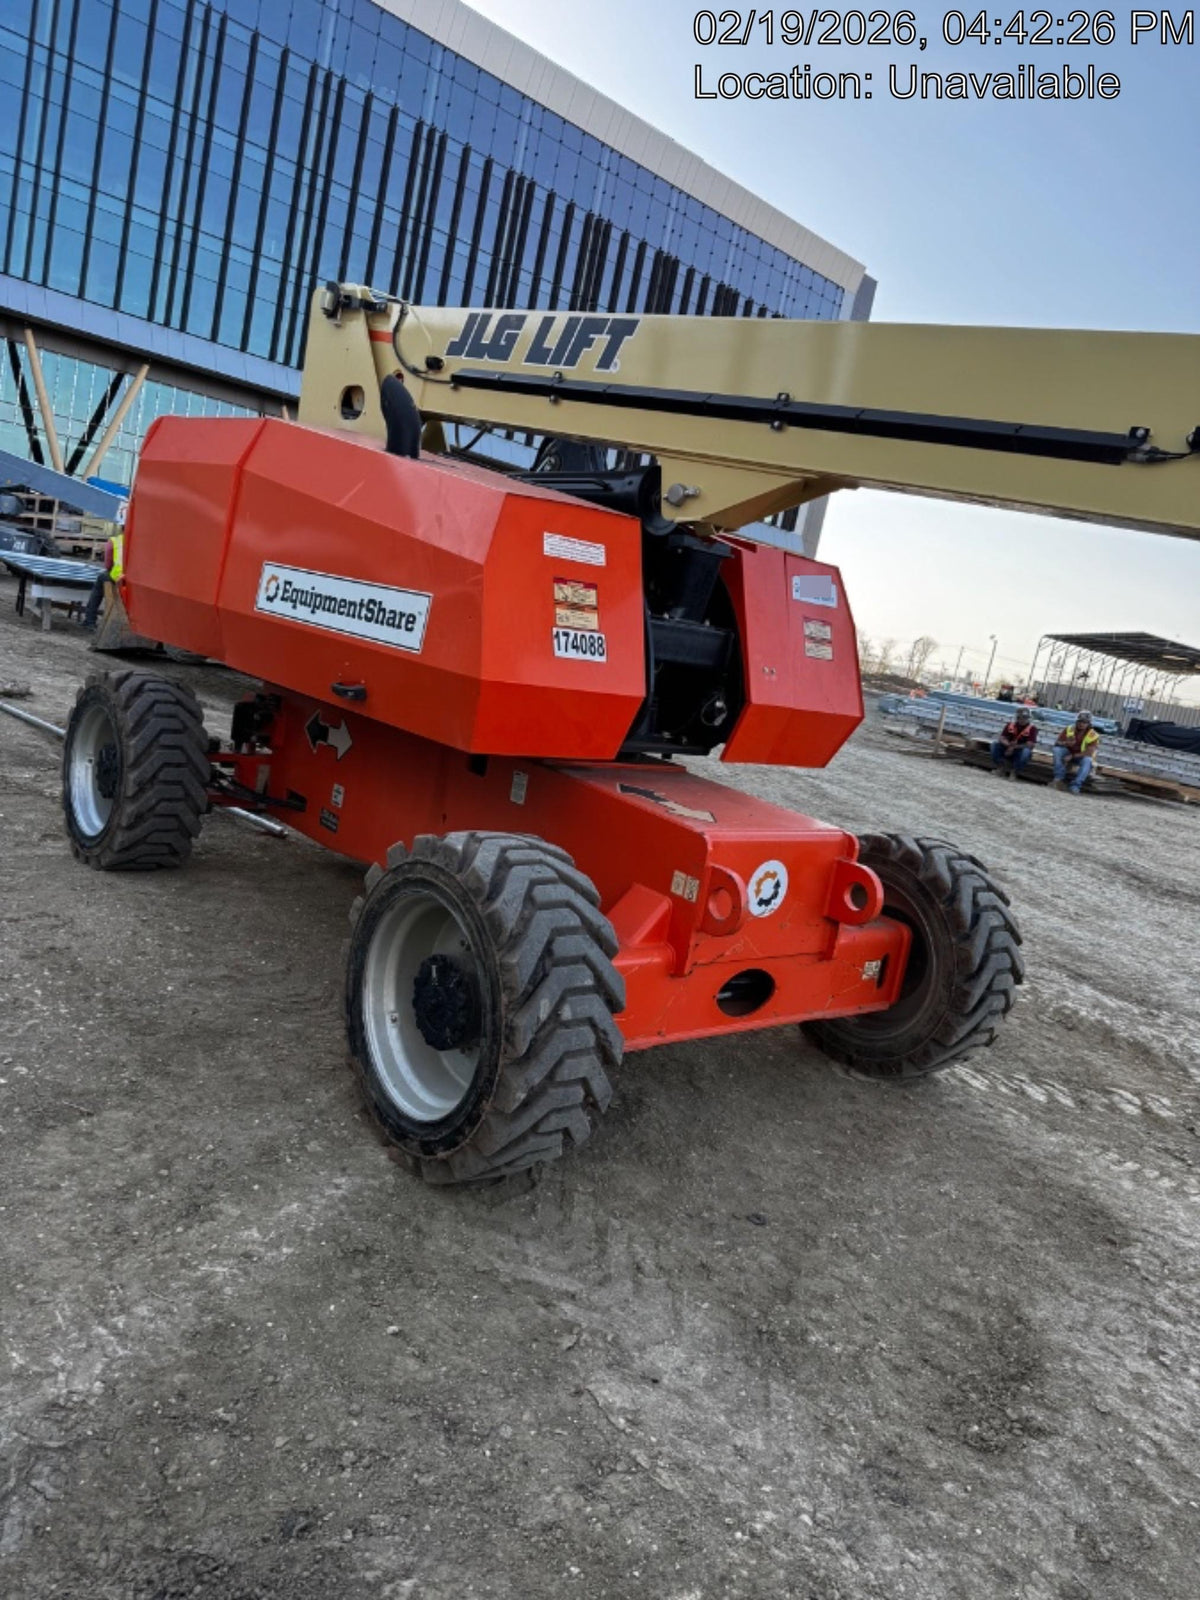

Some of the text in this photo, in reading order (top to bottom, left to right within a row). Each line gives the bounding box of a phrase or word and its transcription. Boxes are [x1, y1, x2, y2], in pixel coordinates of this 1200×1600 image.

[445, 312, 641, 371] JLG LIFT
[280, 580, 417, 632] EquipmentShare
[554, 630, 605, 656] 174088
